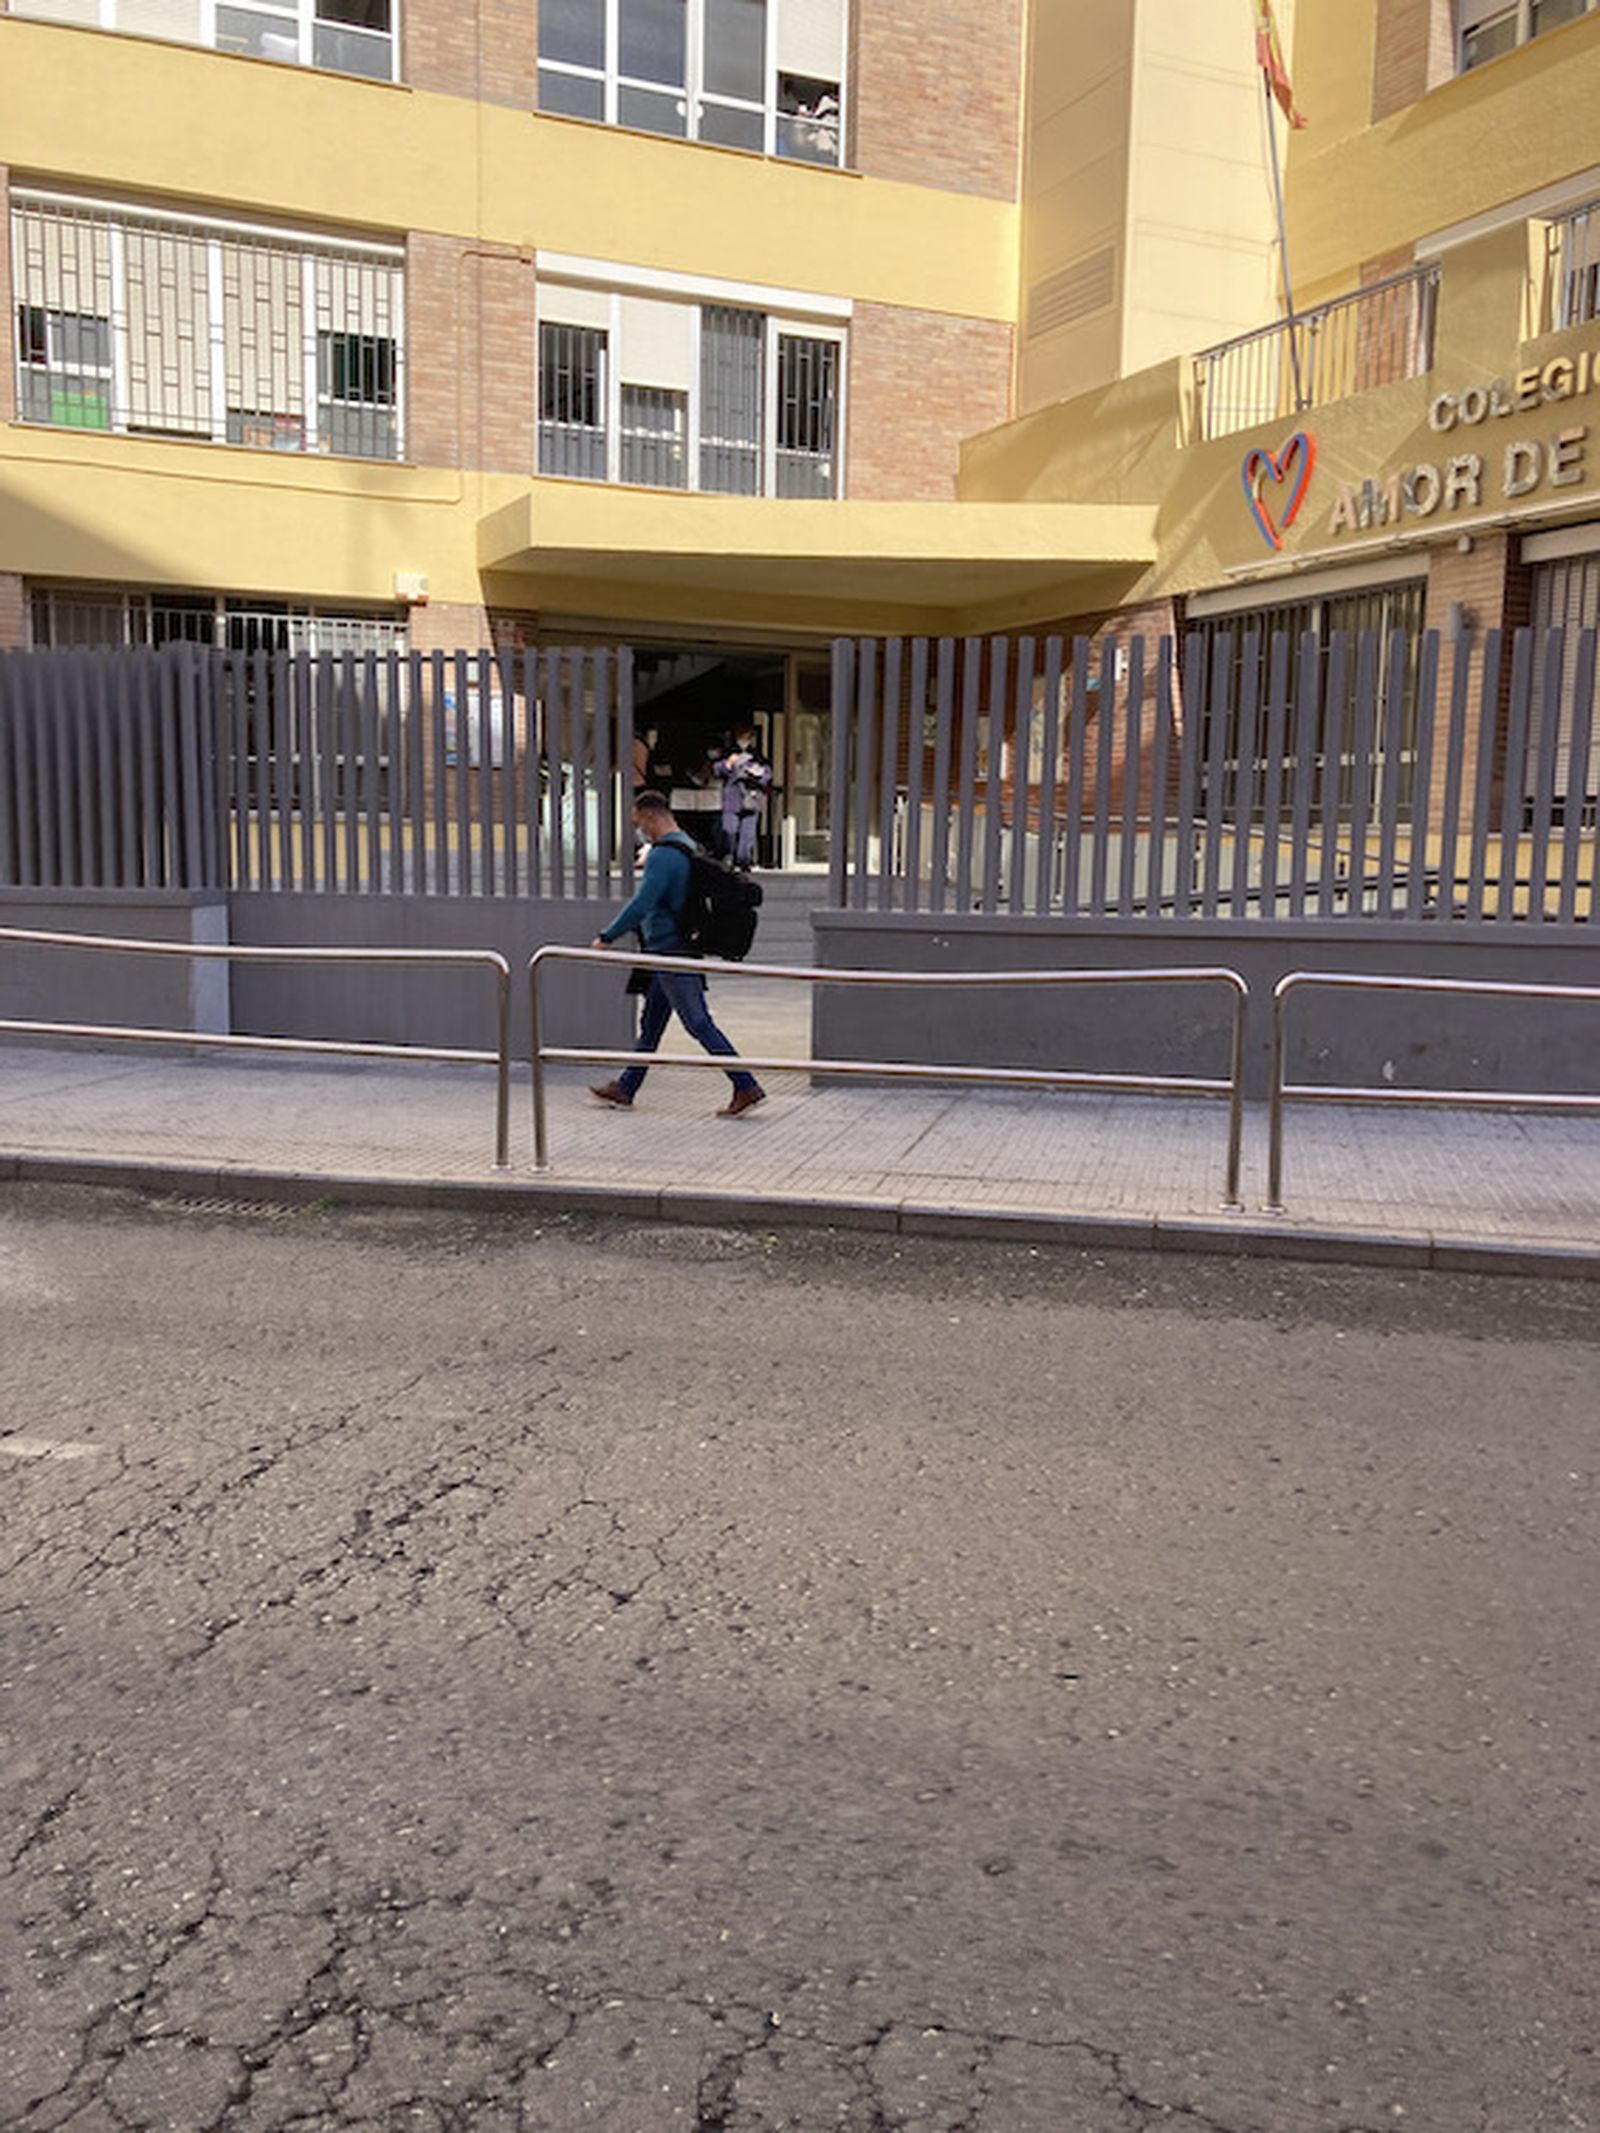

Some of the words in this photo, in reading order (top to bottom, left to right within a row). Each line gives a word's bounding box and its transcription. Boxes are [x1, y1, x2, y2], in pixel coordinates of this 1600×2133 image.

[1429, 352, 1600, 432] COLEGI
[1330, 454, 1482, 535] AMOR
[1503, 426, 1587, 498] DE
